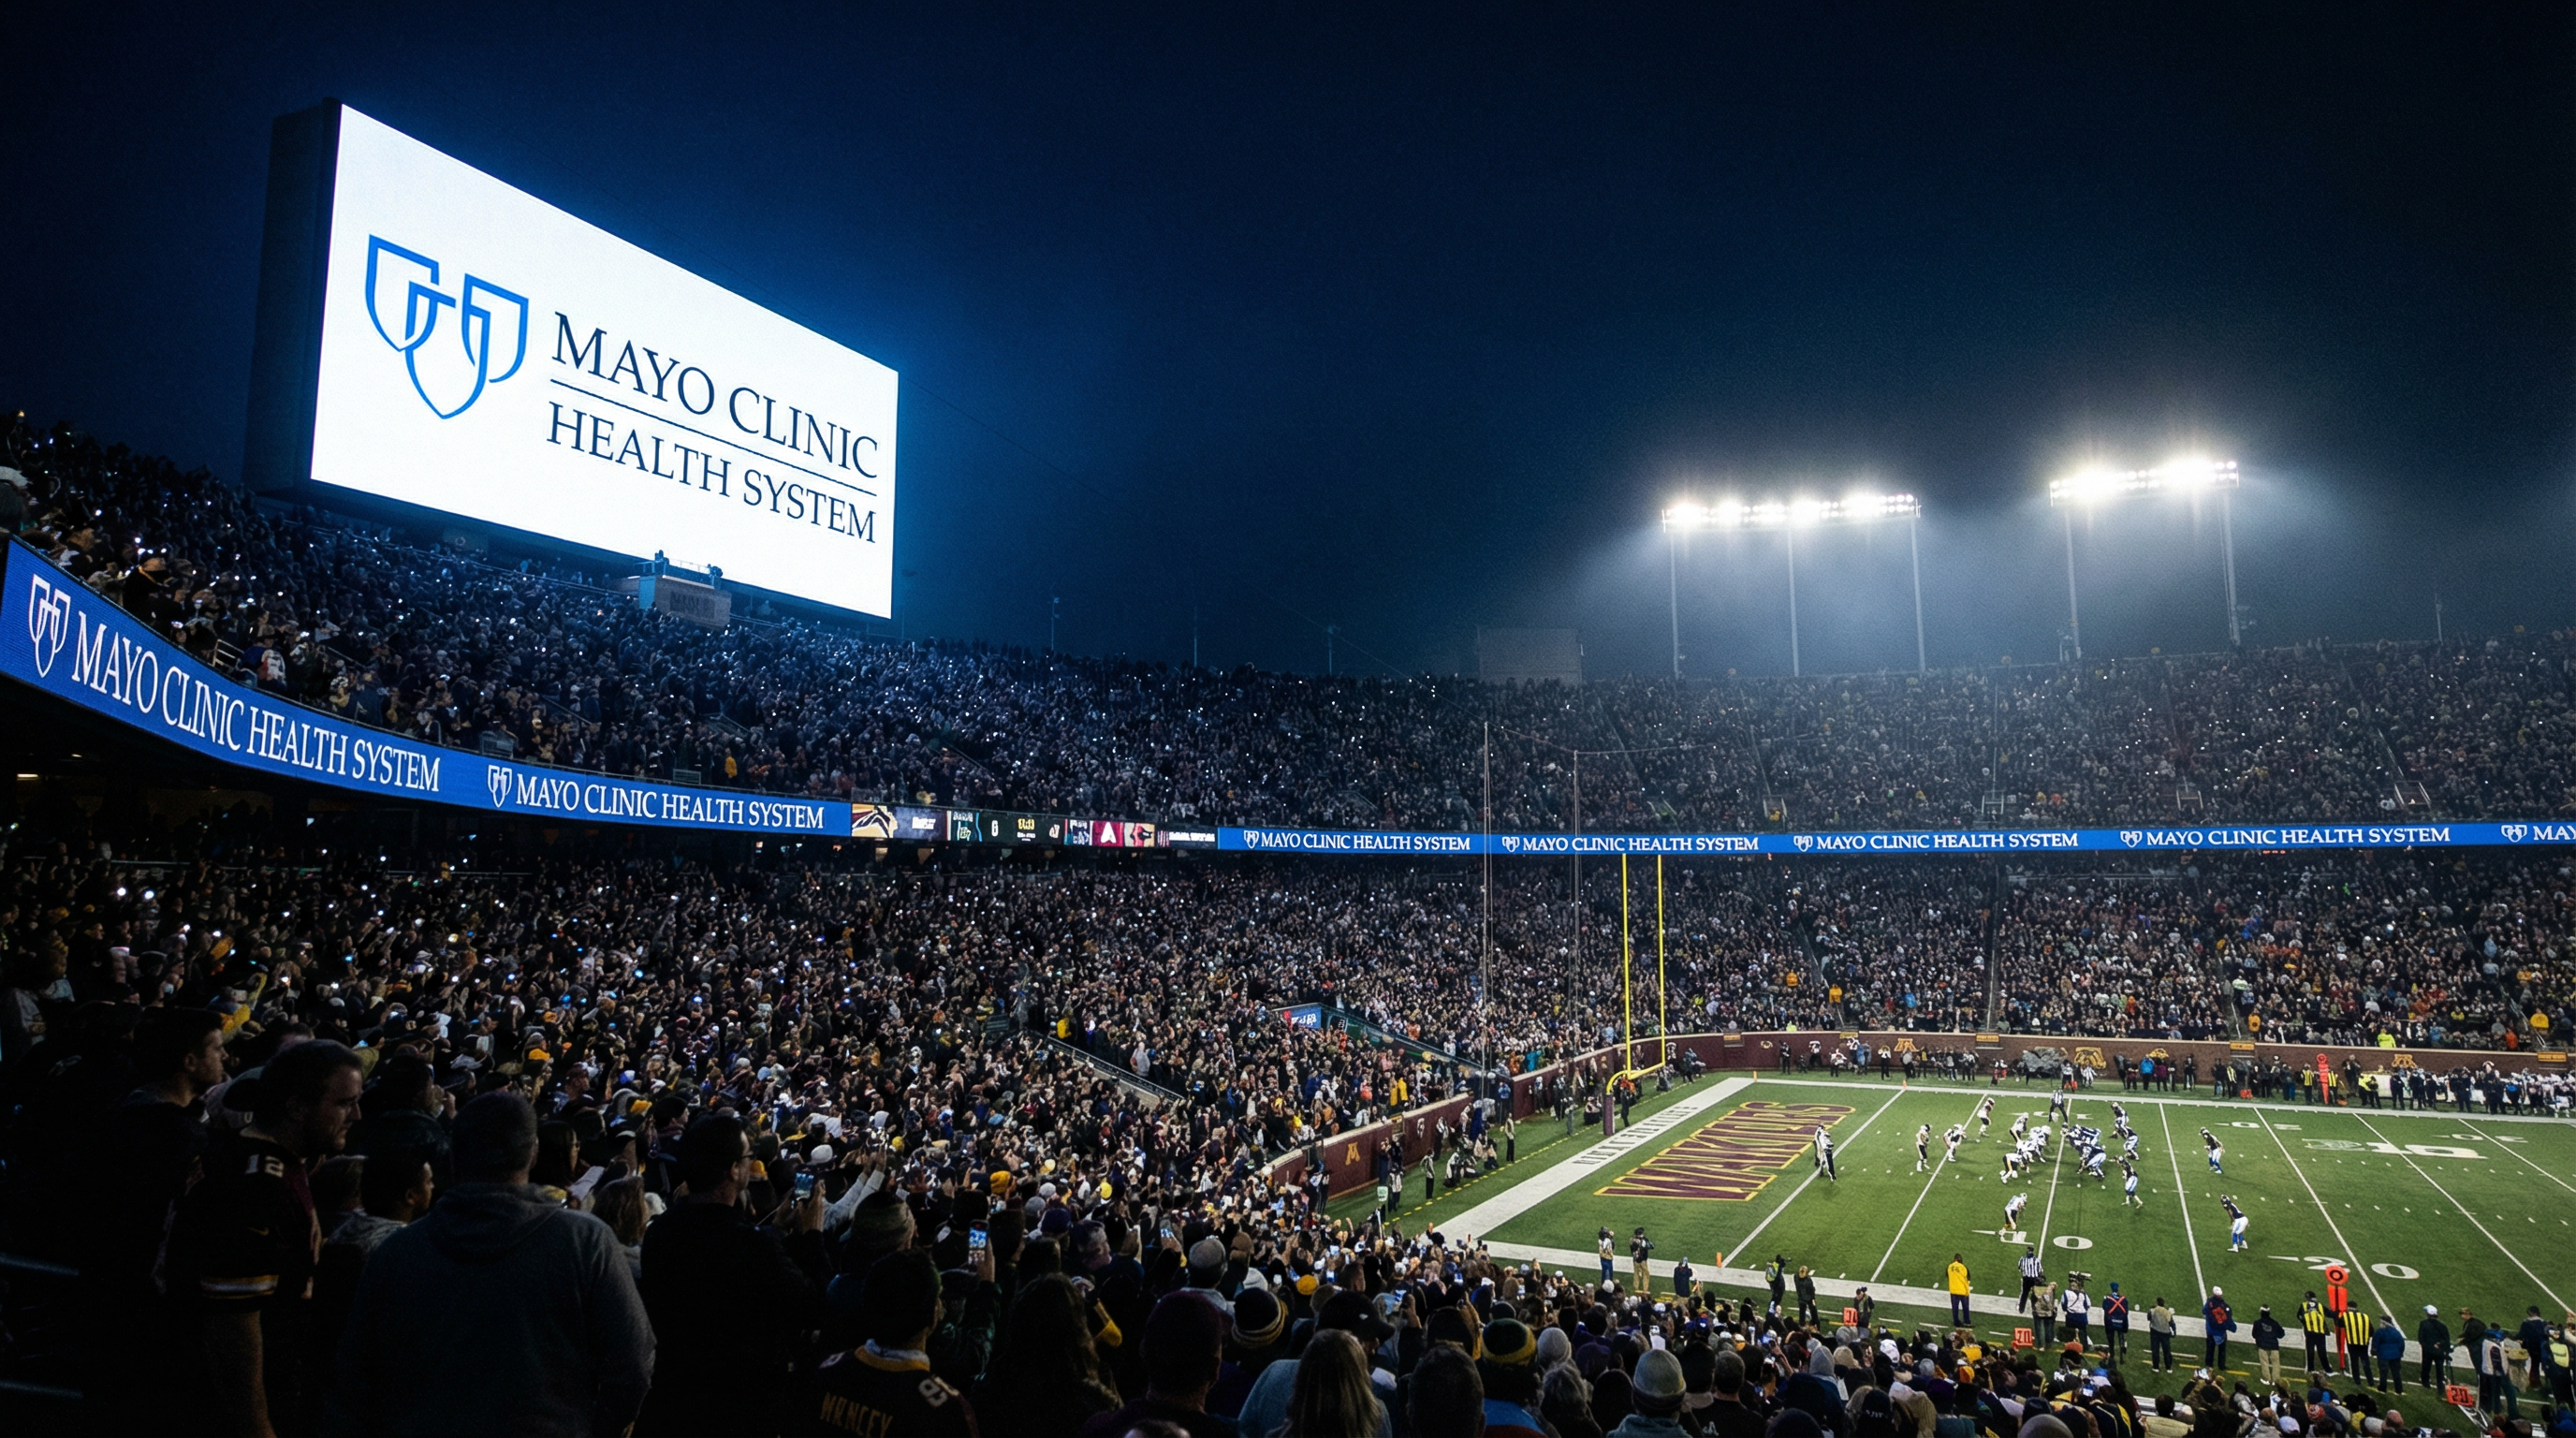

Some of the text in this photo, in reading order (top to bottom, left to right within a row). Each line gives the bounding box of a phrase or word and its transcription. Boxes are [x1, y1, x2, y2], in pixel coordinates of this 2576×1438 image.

[551, 311, 878, 479] MAYO CLINIC
[546, 401, 876, 544] HEALTH SYSTEM
[71, 610, 441, 792] MAYO CLINIC HEALTH SYSTEM
[516, 773, 825, 829] MAYO CLINIC HEALTH SYSTEM
[1261, 831, 1471, 851] MAYO CLINIC HEALTH SYSTEM
[1523, 836, 1759, 851] MAYO CLINIC HEALTH SYSTEM
[1816, 832, 2079, 851] MAYO CLINIC HEALTH SYSTEM
[2146, 827, 2451, 846] MAYO CLINIC HEALTH SYSTEM
[243, 1153, 285, 1179] 12
